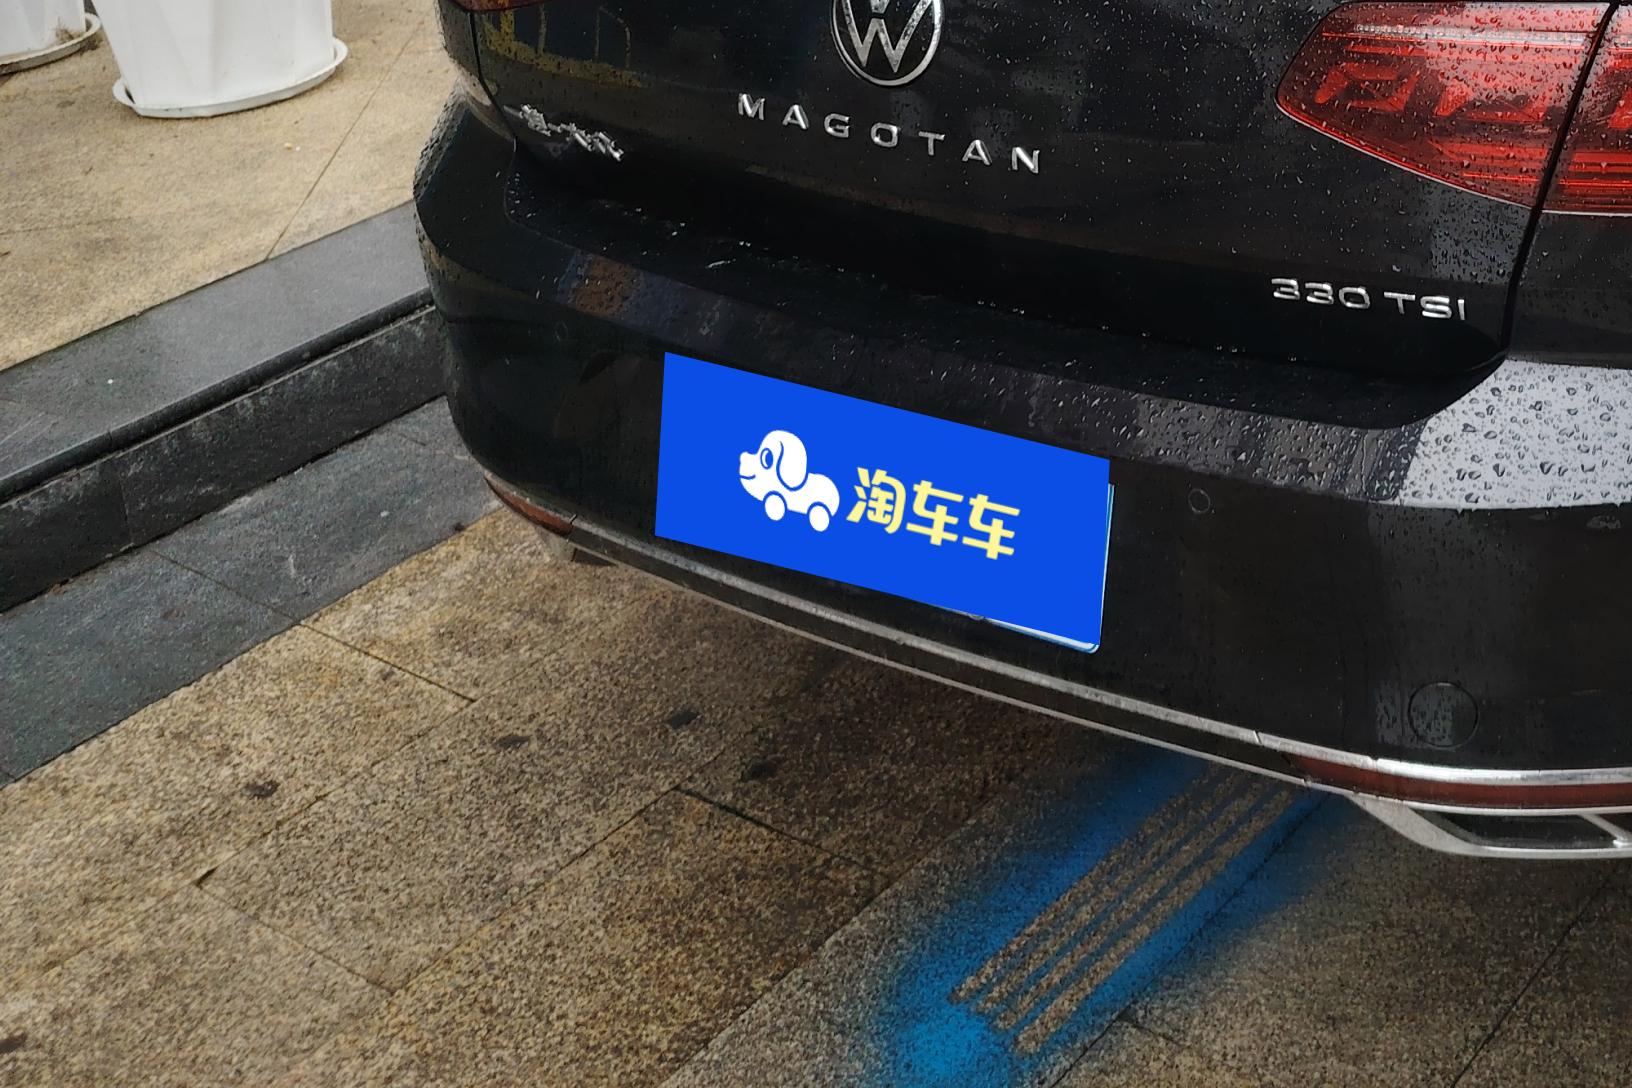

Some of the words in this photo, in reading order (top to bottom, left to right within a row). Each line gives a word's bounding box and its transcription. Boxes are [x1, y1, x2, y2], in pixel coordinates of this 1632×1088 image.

[737, 92, 1041, 175] MAGOTAN
[1271, 278, 1371, 310] 330
[1384, 291, 1466, 321] TSI
